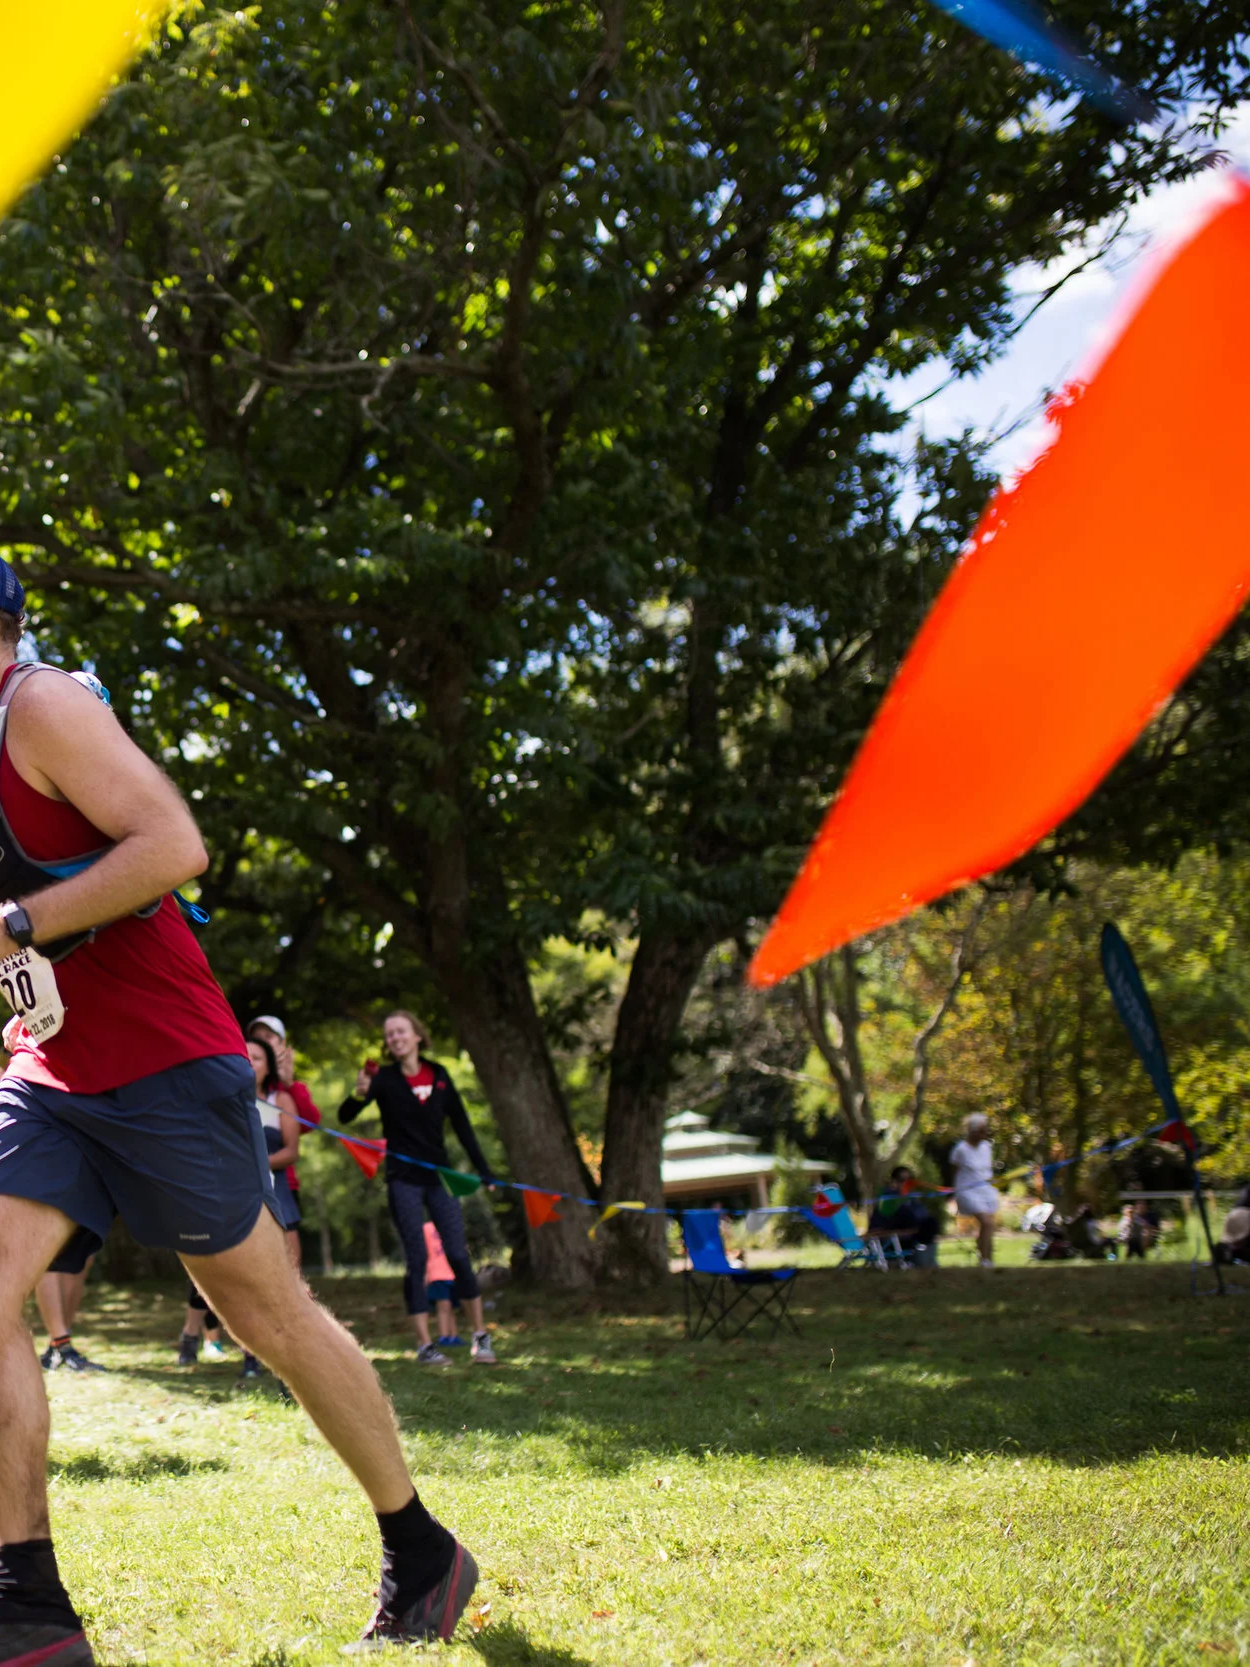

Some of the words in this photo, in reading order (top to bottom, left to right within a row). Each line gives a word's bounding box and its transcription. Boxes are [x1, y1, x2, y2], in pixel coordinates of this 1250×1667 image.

[4, 953, 32, 974] RACE
[0, 969, 36, 1018] 20
[40, 1012, 56, 1031] 2018
